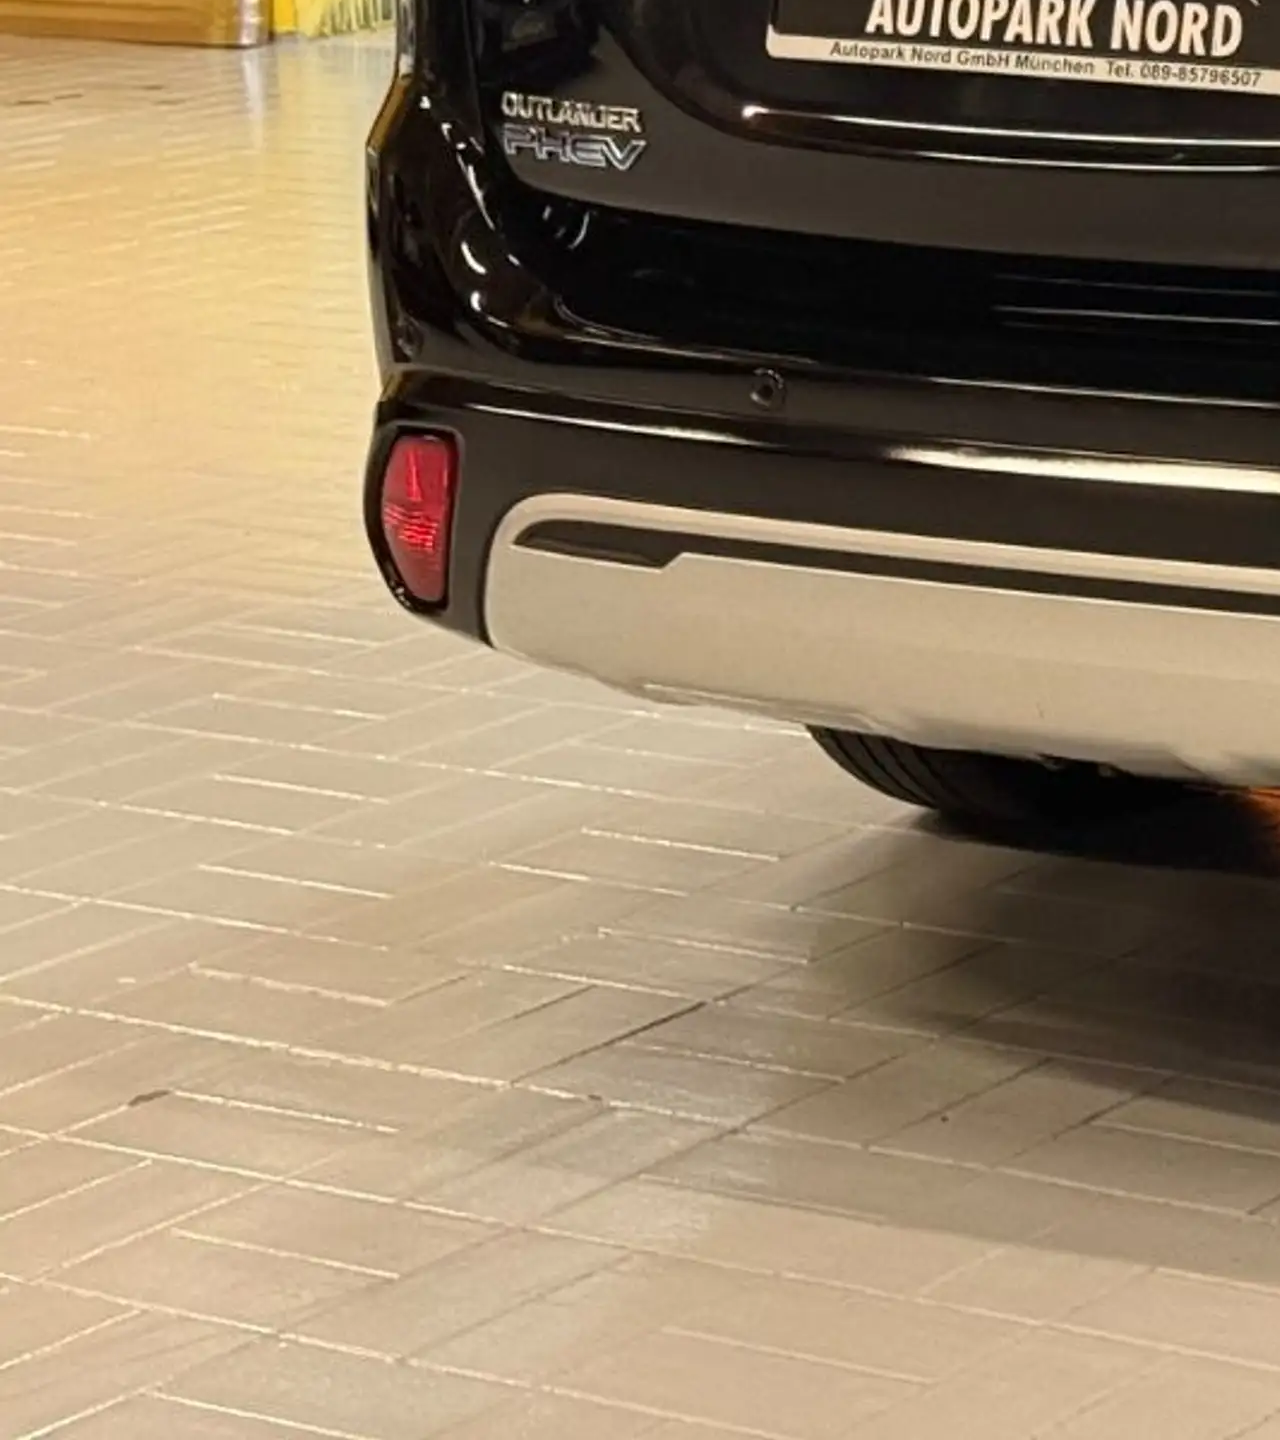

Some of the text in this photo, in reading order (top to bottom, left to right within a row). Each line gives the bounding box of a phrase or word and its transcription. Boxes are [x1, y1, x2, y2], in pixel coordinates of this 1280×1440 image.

[829, 40, 1262, 87] Autopark Nord GmbH München Tel. 089-85796507
[501, 91, 641, 133] OUTLANDER
[503, 122, 646, 170] PHEV
